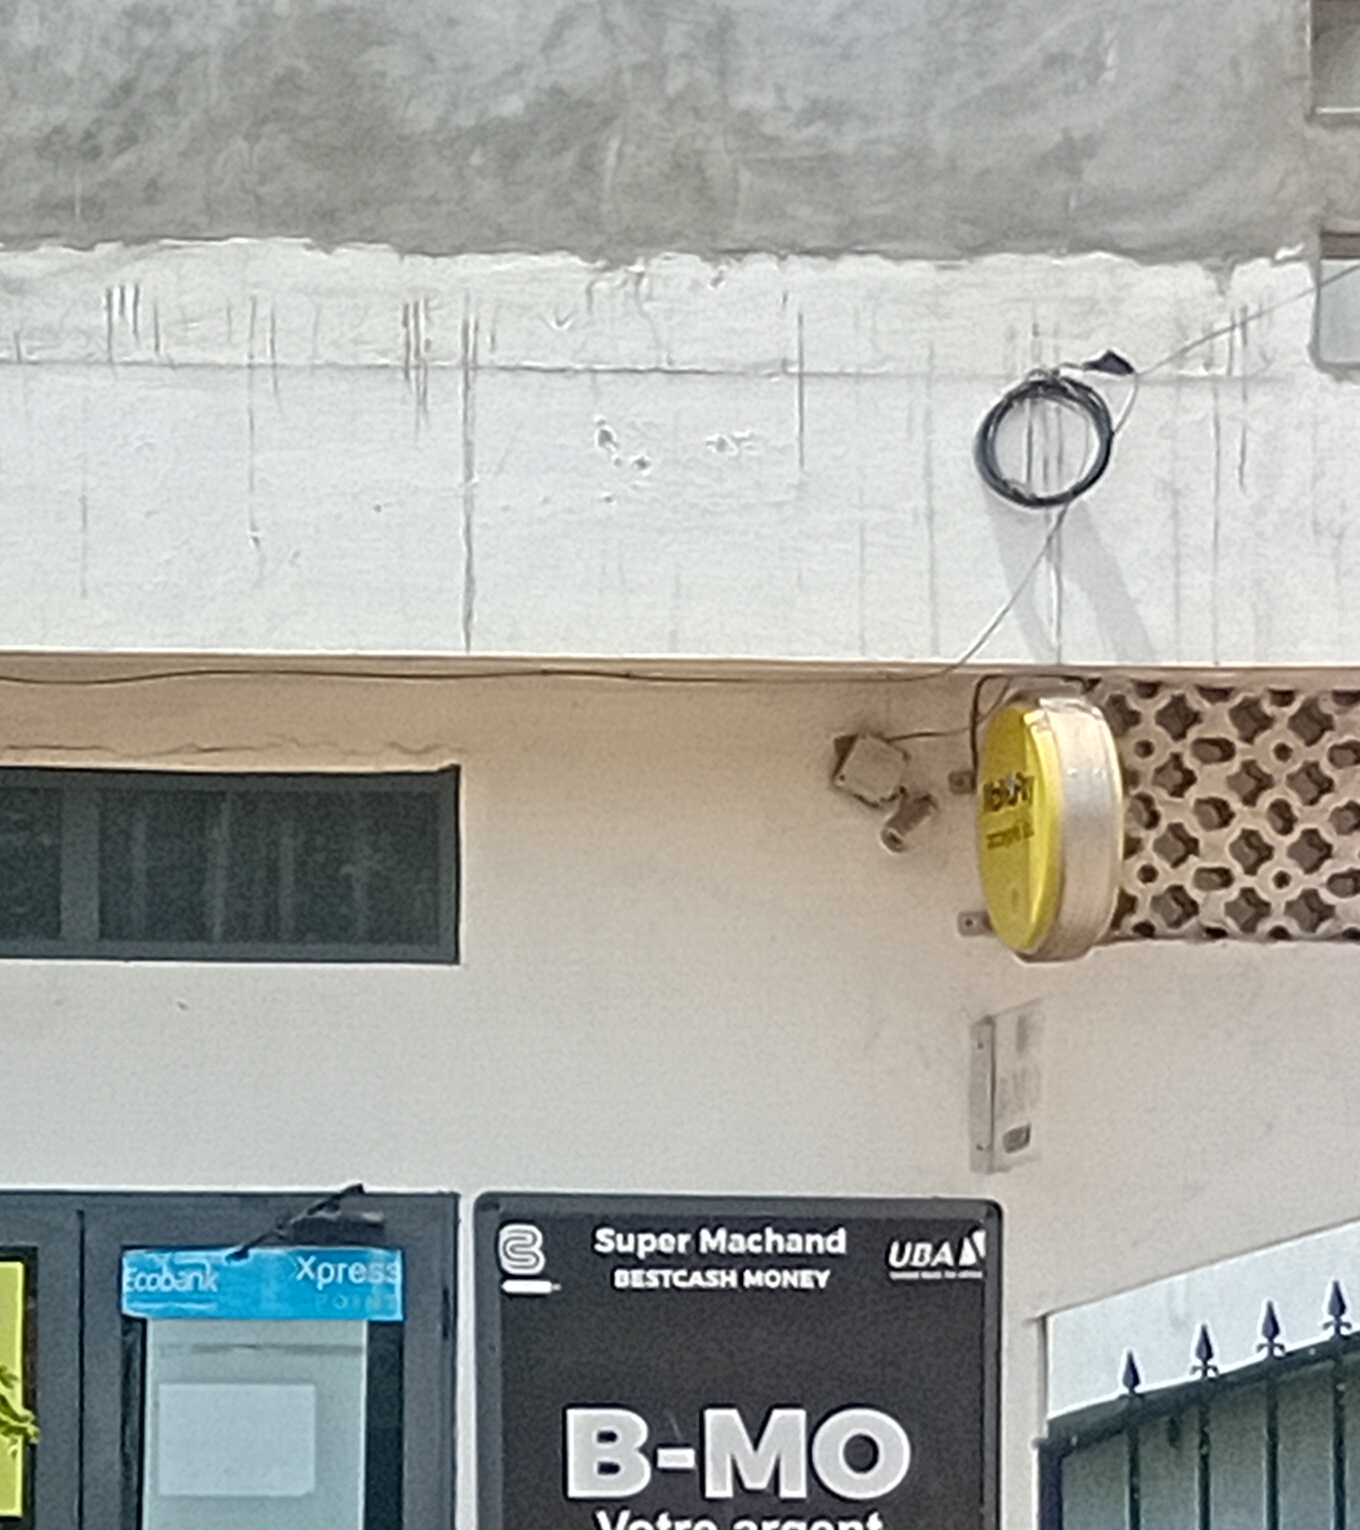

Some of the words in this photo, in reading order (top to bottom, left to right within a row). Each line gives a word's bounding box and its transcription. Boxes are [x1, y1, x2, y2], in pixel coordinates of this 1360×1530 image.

[593, 1227, 689, 1259] Super
[699, 1227, 848, 1256] Machand
[888, 1240, 955, 1269] UBA
[124, 1259, 219, 1294] Ecobank
[294, 1255, 399, 1292] Xpress
[613, 1269, 738, 1289] BESTCASH
[743, 1269, 832, 1289] MONEY
[566, 1407, 912, 1501] B-MO
